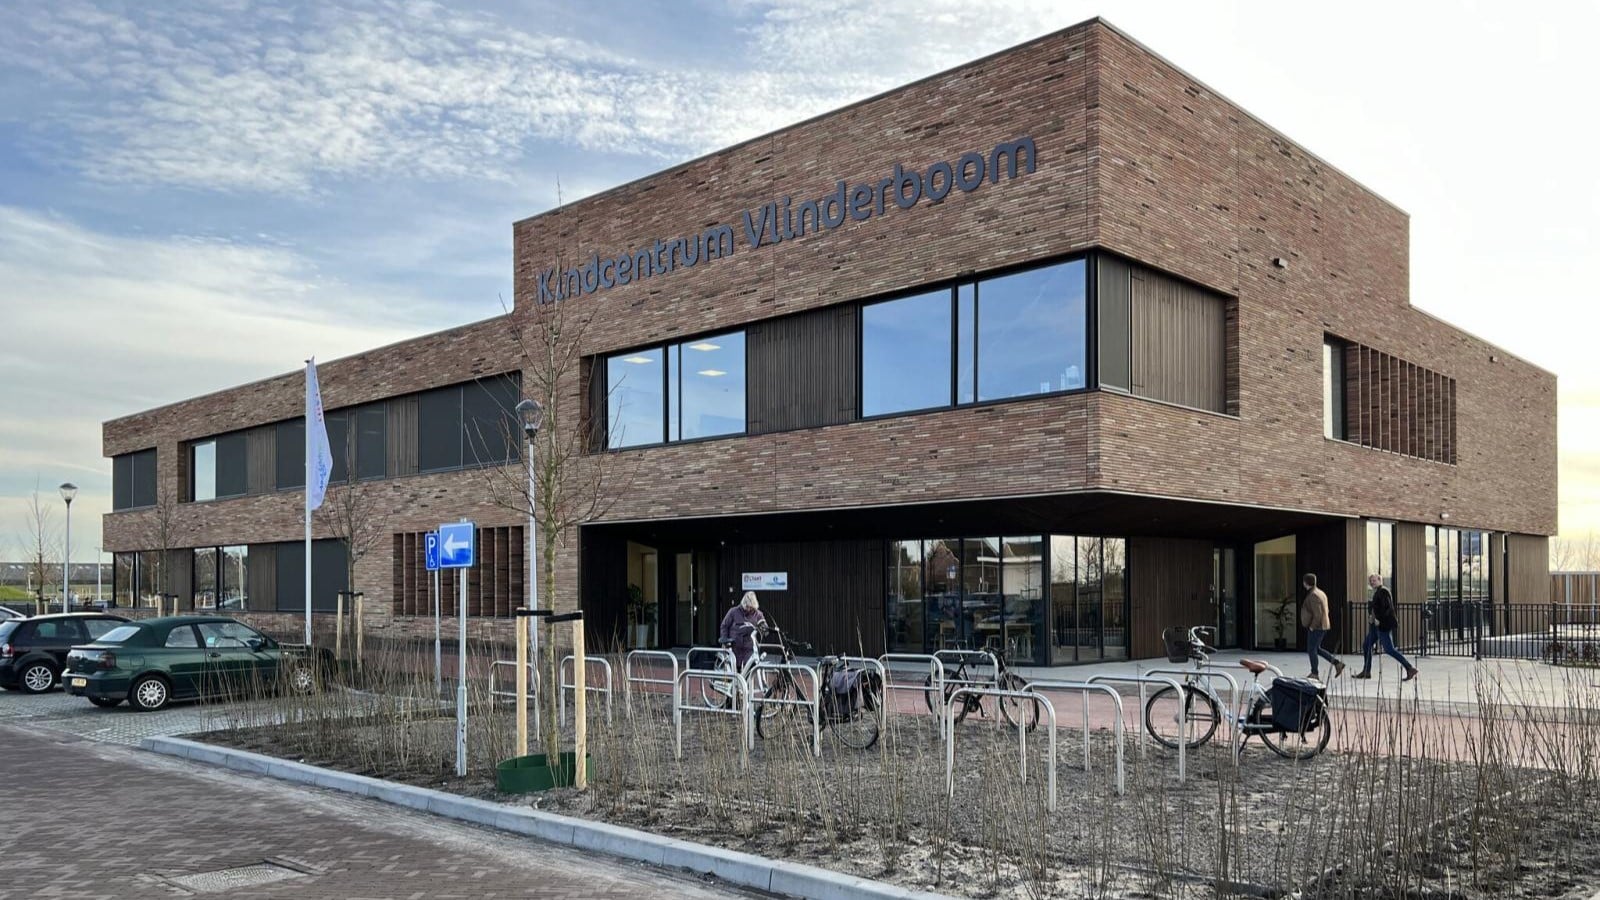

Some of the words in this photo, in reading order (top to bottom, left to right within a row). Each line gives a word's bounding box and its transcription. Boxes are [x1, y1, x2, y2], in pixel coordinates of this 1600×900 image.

[537, 226, 734, 304] Kindcentrum
[743, 136, 1036, 248] Vlinderboom
[428, 537, 436, 555] P
